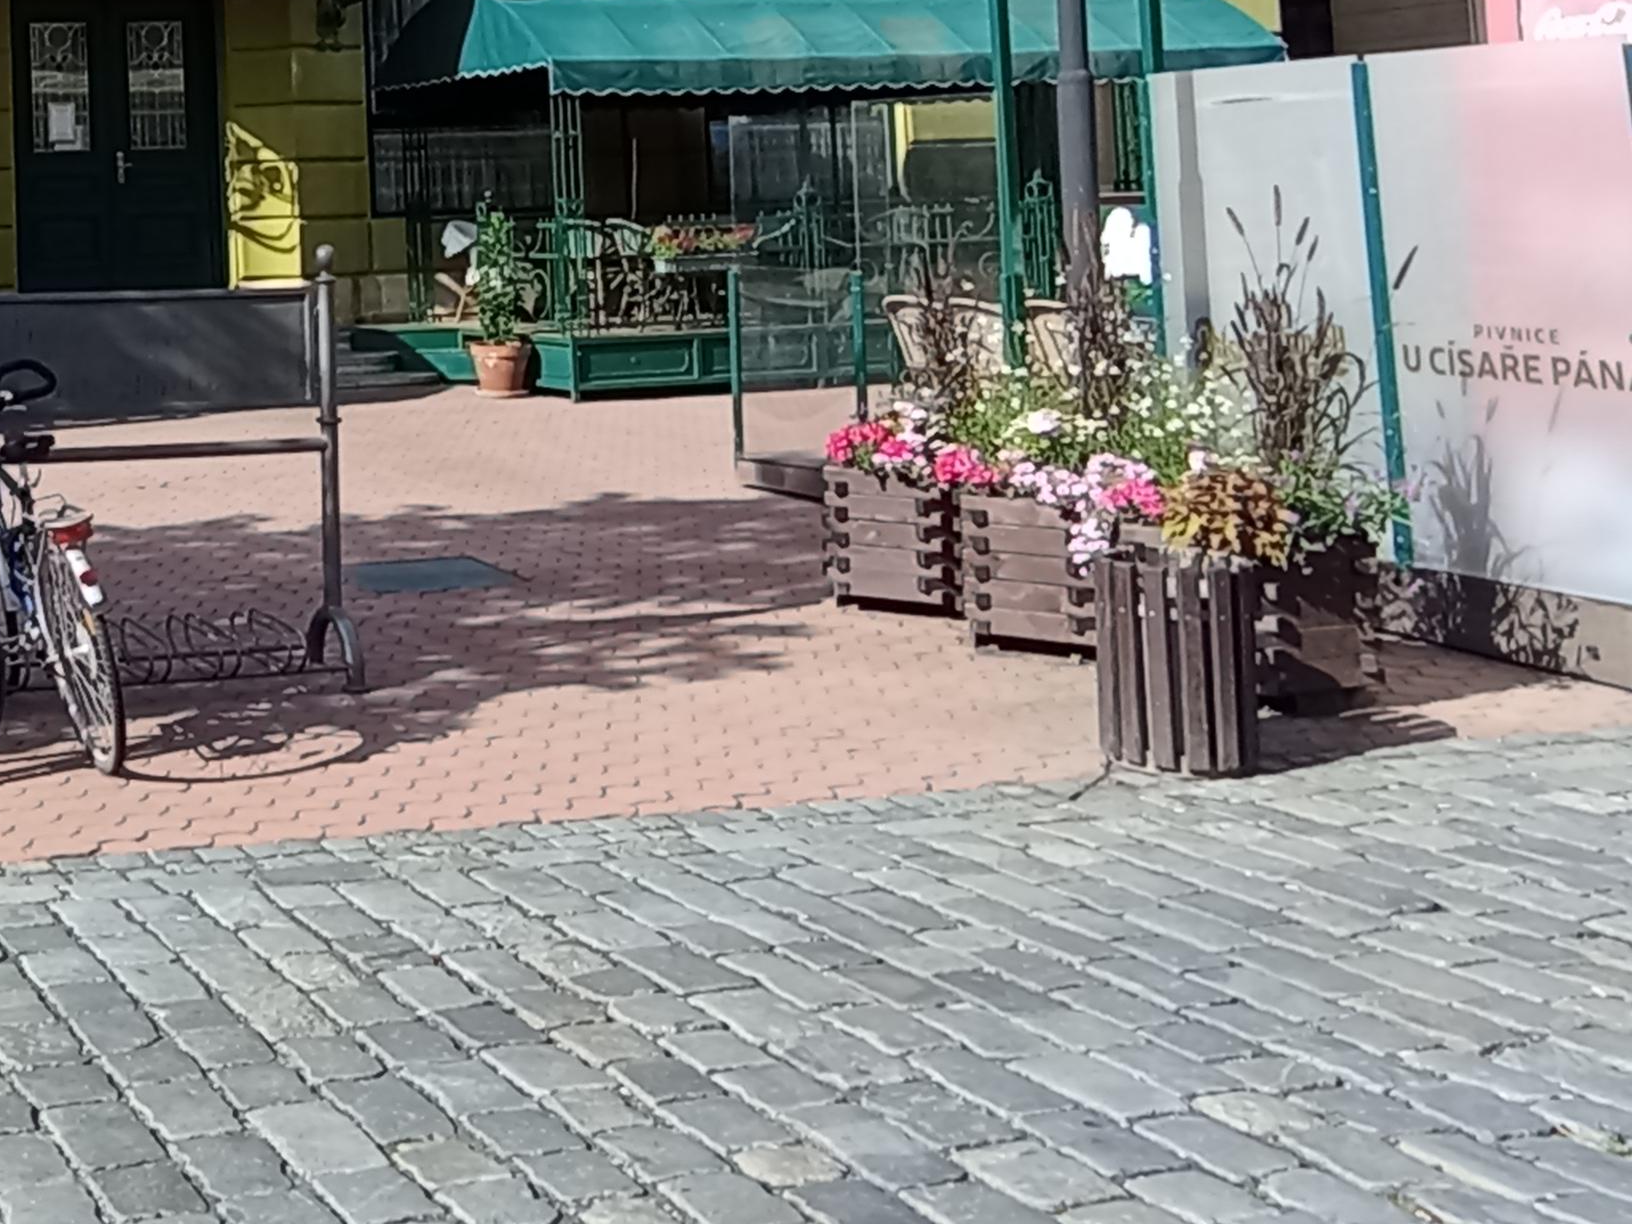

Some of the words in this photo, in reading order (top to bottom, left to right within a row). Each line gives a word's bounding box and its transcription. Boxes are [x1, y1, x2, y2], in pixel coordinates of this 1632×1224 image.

[1473, 324, 1561, 345] PIVNICE
[1402, 343, 1421, 373] U
[1429, 339, 1544, 385] CÍSAŘE
[1551, 349, 1632, 392] PÁN
